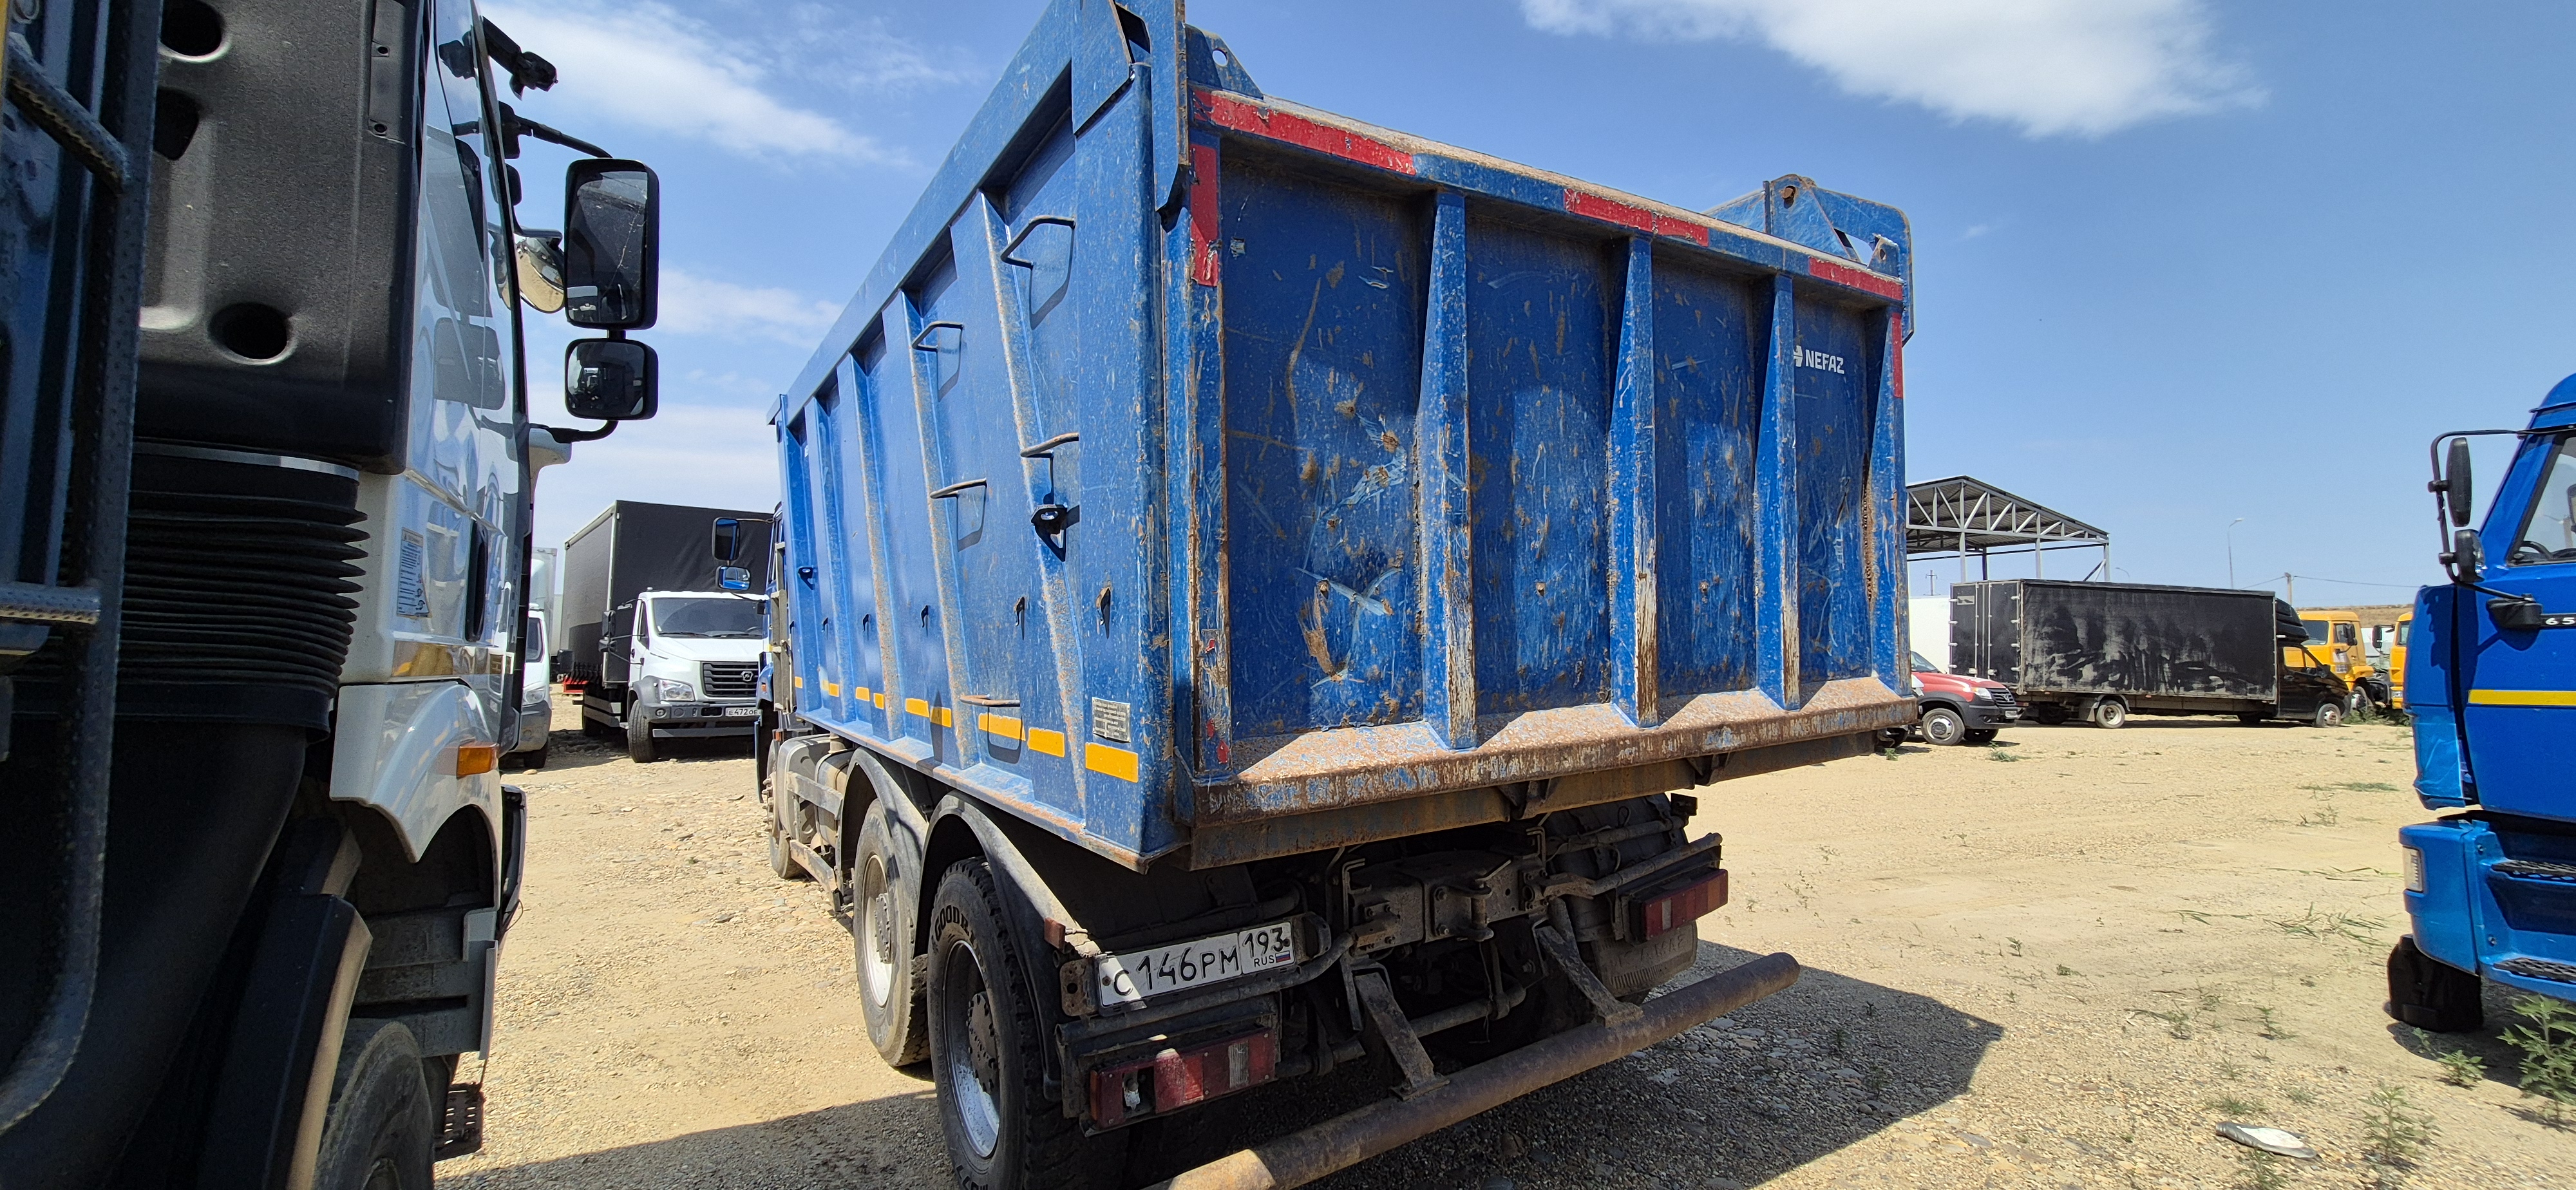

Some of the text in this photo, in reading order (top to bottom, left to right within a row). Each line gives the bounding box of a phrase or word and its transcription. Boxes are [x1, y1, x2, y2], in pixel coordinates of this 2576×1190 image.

[1805, 349, 1845, 375] NEFAZ
[2545, 617, 2575, 625] 65
[1242, 927, 1283, 958] 193
[1253, 956, 1276, 968] RUS
